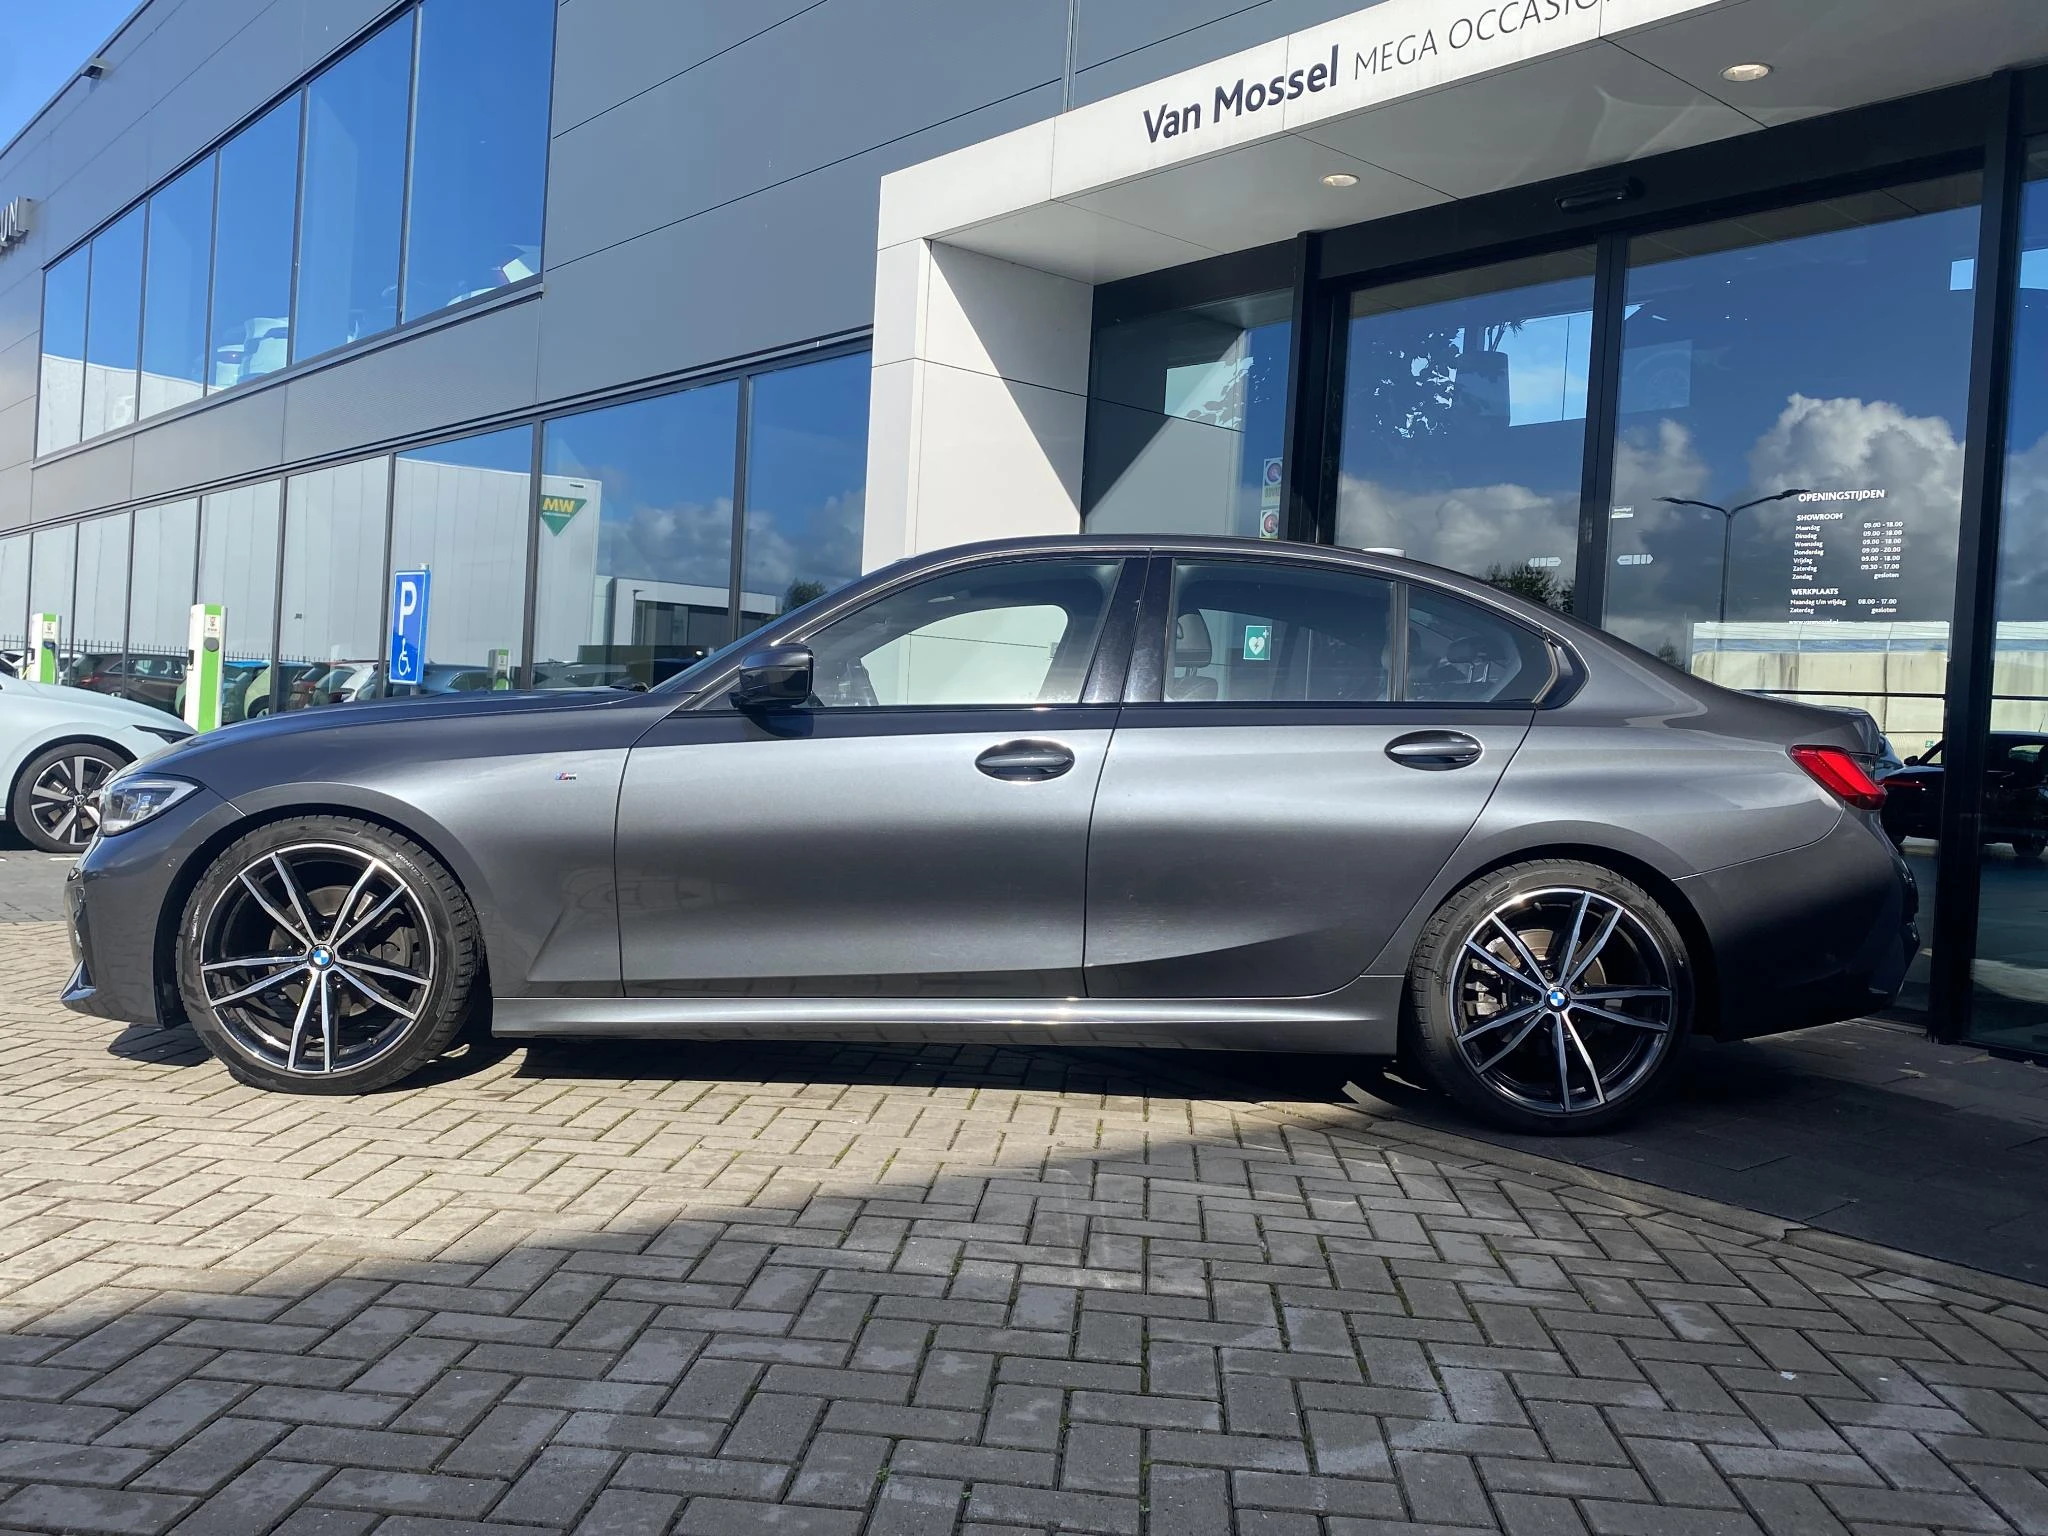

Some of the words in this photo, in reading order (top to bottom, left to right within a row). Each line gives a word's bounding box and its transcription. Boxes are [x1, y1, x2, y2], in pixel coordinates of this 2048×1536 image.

[1143, 103, 1201, 144] Van
[1213, 43, 1339, 124] Mossel
[1355, 28, 1438, 81] MEGA
[1798, 489, 1885, 501] OPENINGSTIJDEN
[1796, 512, 1844, 521] SHOWROOM
[398, 581, 418, 636] P
